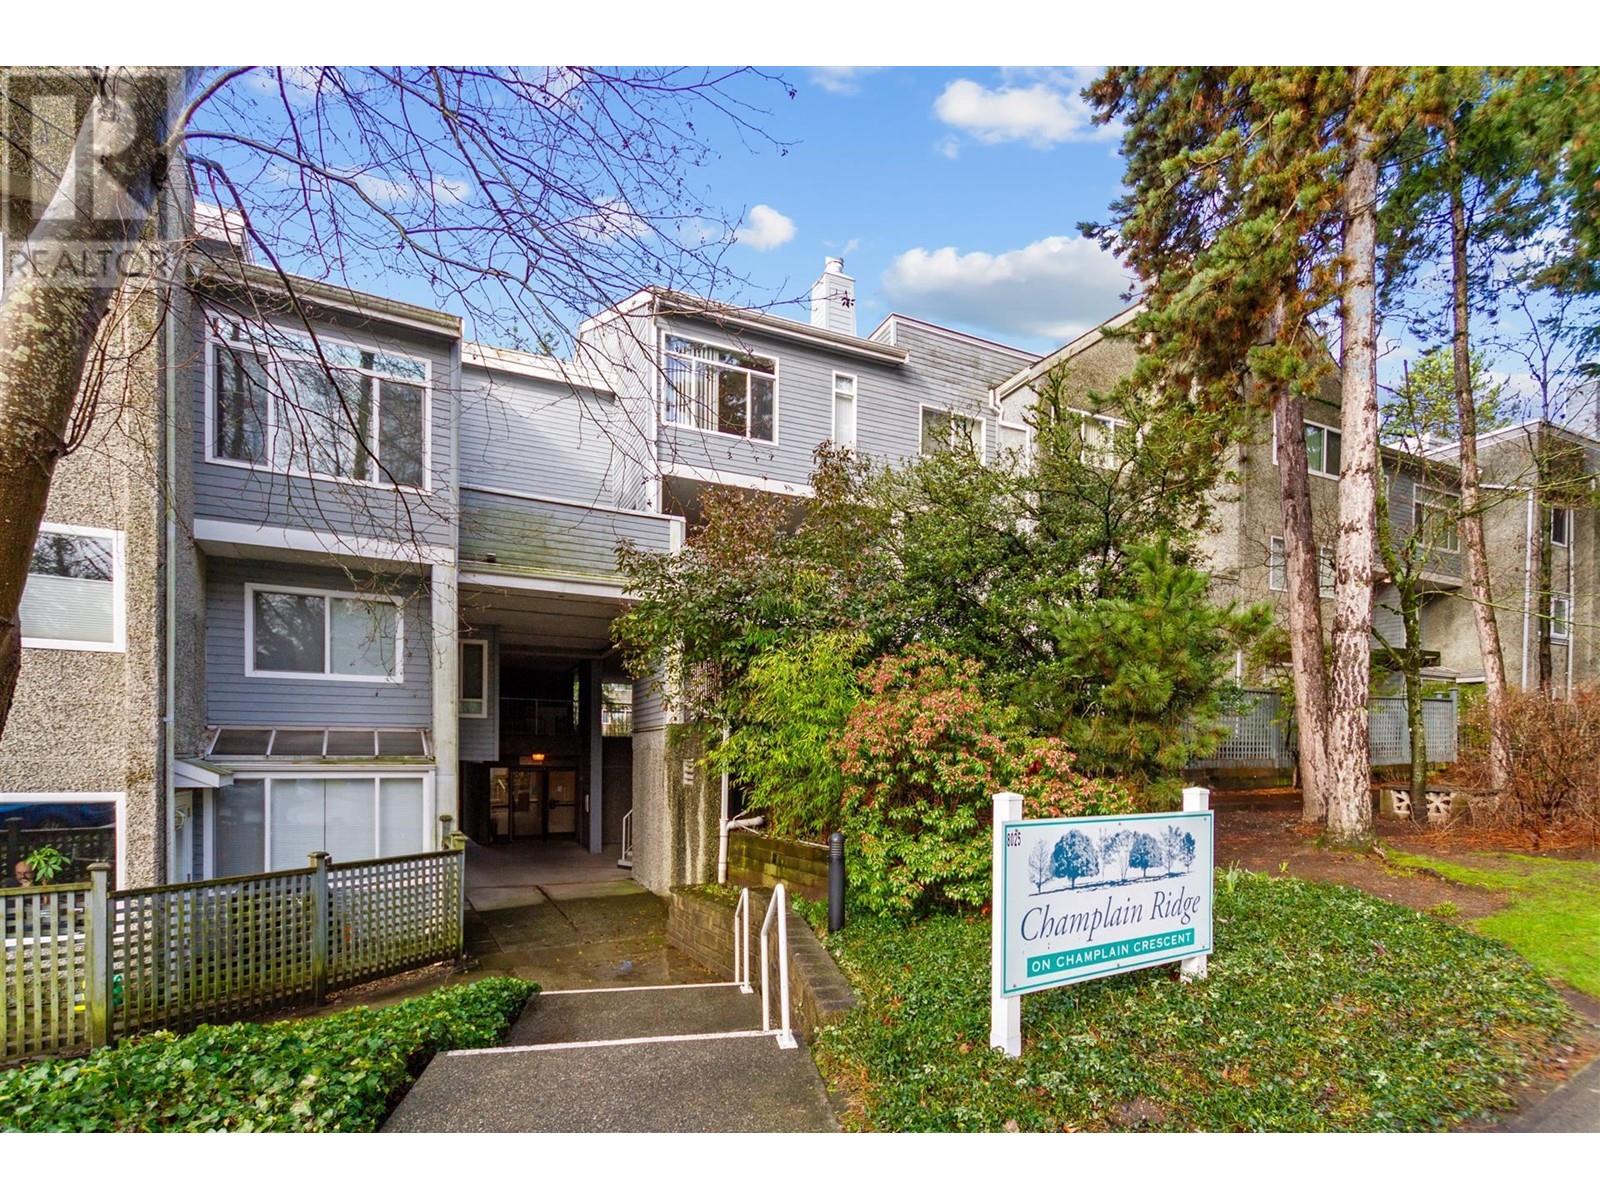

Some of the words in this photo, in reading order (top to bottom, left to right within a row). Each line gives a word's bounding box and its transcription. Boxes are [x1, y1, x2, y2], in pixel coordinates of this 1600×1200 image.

[1021, 896, 1142, 942] Champlain
[1150, 887, 1200, 925] Ridge
[1031, 960, 1051, 972] ON
[1056, 946, 1129, 967] CHAMPLAIN
[1134, 932, 1192, 951] CRESCENT
